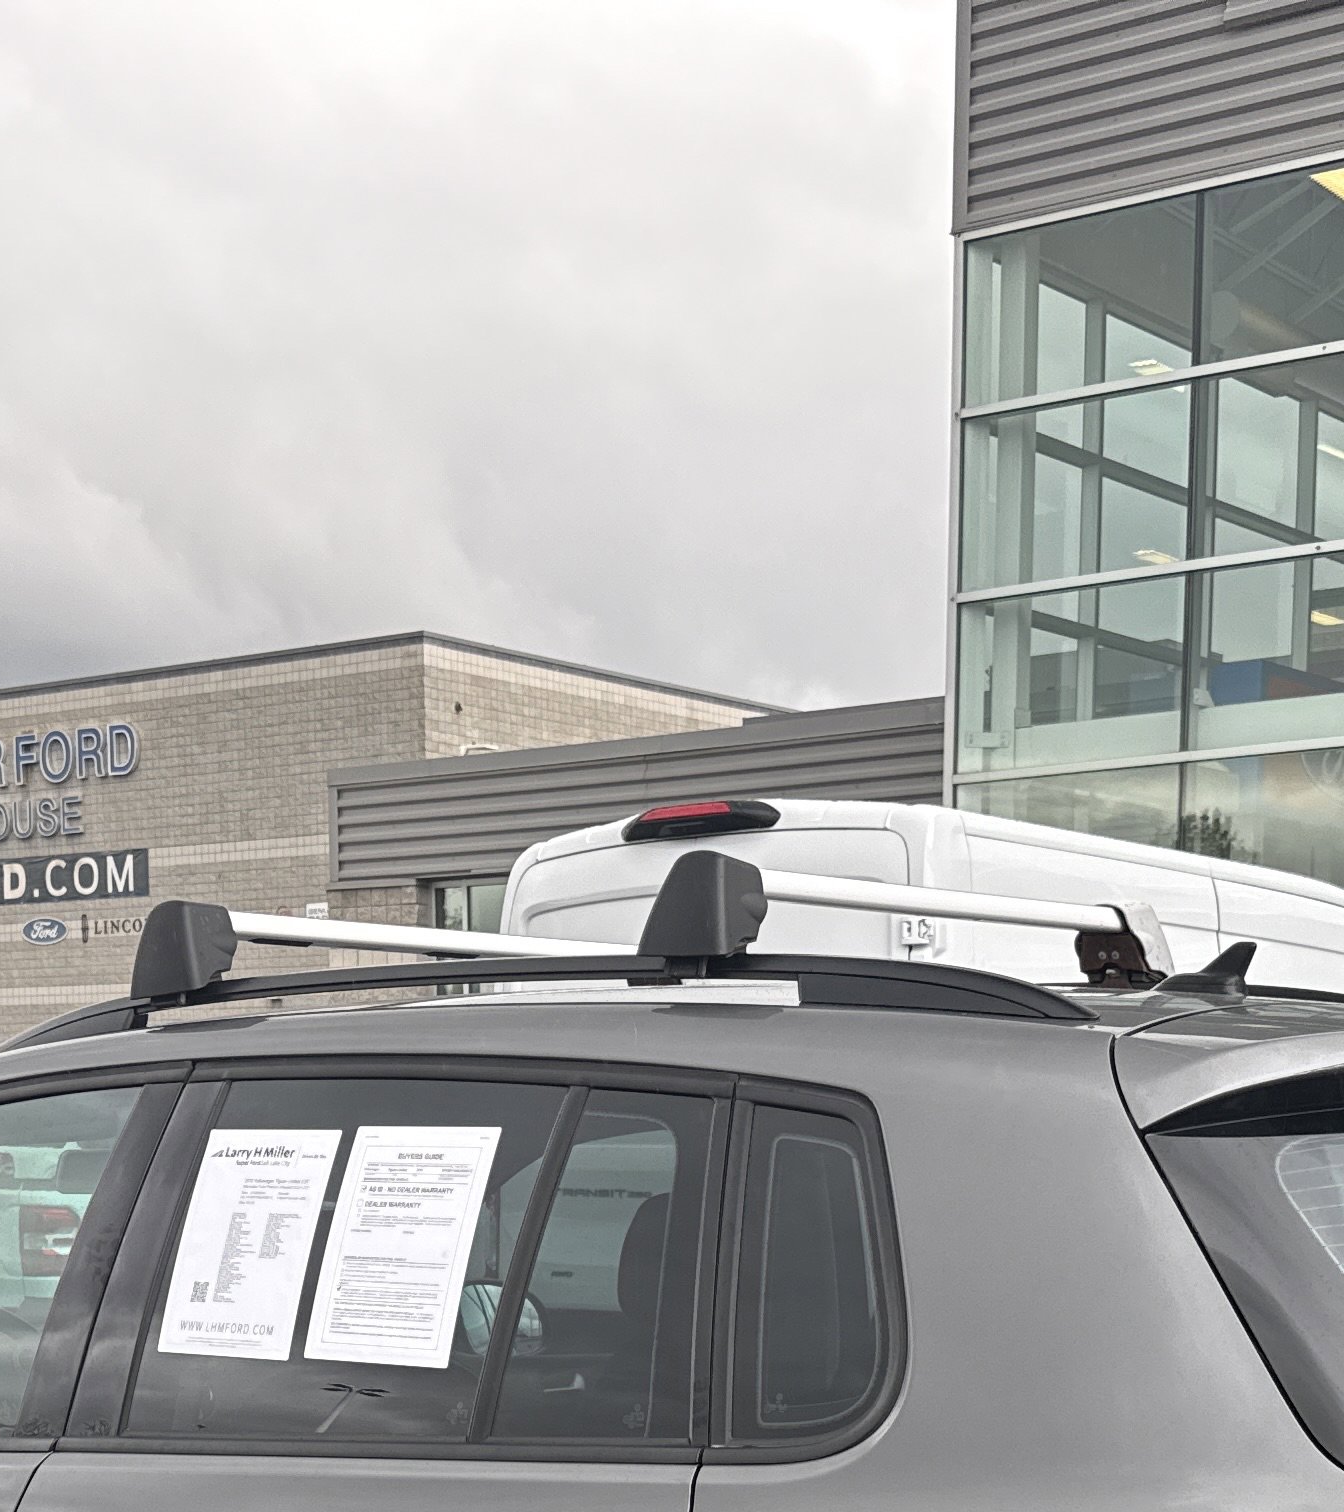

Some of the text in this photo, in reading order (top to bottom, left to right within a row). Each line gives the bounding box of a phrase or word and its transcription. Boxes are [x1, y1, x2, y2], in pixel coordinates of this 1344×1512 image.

[13, 722, 142, 786] FORD
[94, 918, 147, 935] LINCO
[225, 1145, 296, 1160] Larry H Miller
[180, 1319, 275, 1336] WWWLHMFORDCOM
